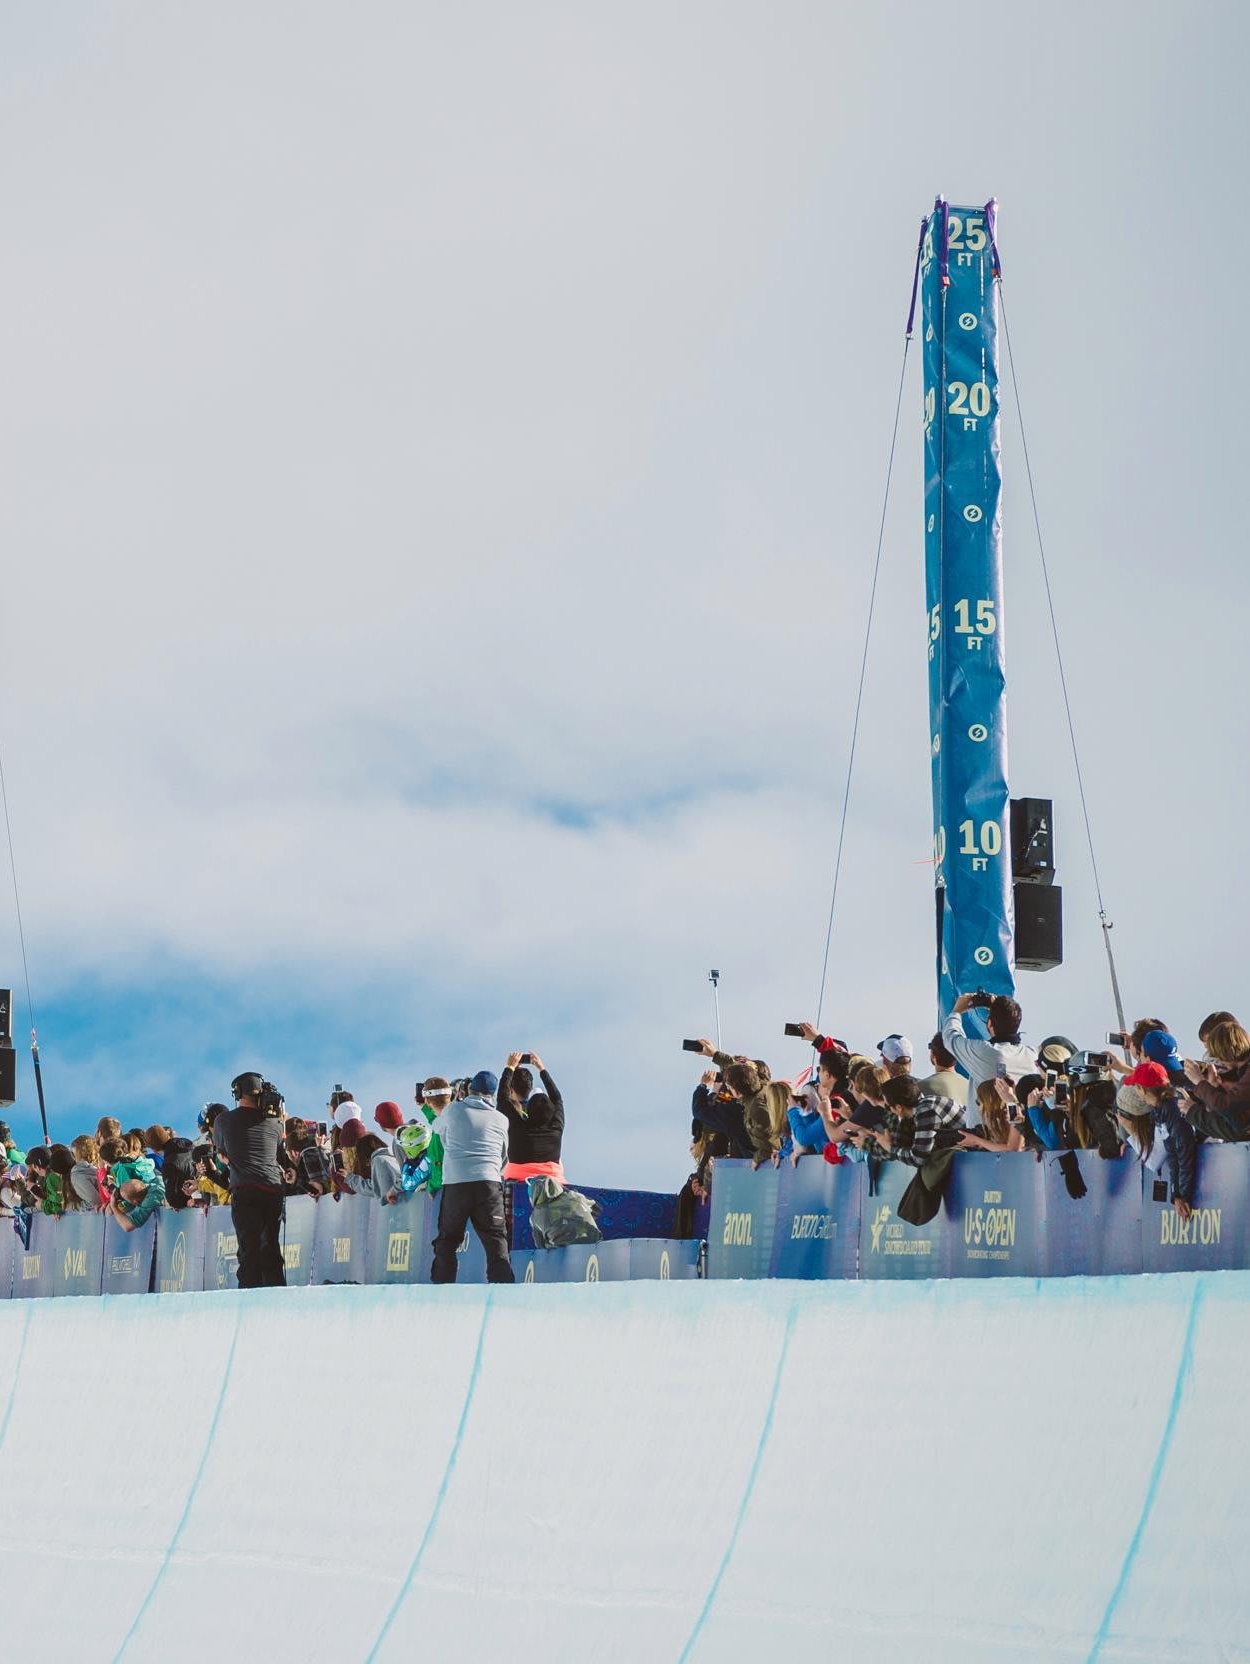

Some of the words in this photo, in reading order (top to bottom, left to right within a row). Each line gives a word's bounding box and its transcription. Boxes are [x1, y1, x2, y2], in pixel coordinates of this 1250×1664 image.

[948, 217, 986, 251] 25
[957, 252, 974, 267] FT
[948, 381, 991, 417] 20
[963, 418, 978, 432] FT
[954, 599, 996, 635] 15
[968, 637, 983, 650] FT
[959, 819, 1002, 856] 10
[972, 858, 989, 872] FT
[1160, 1208, 1222, 1246] BURTON
